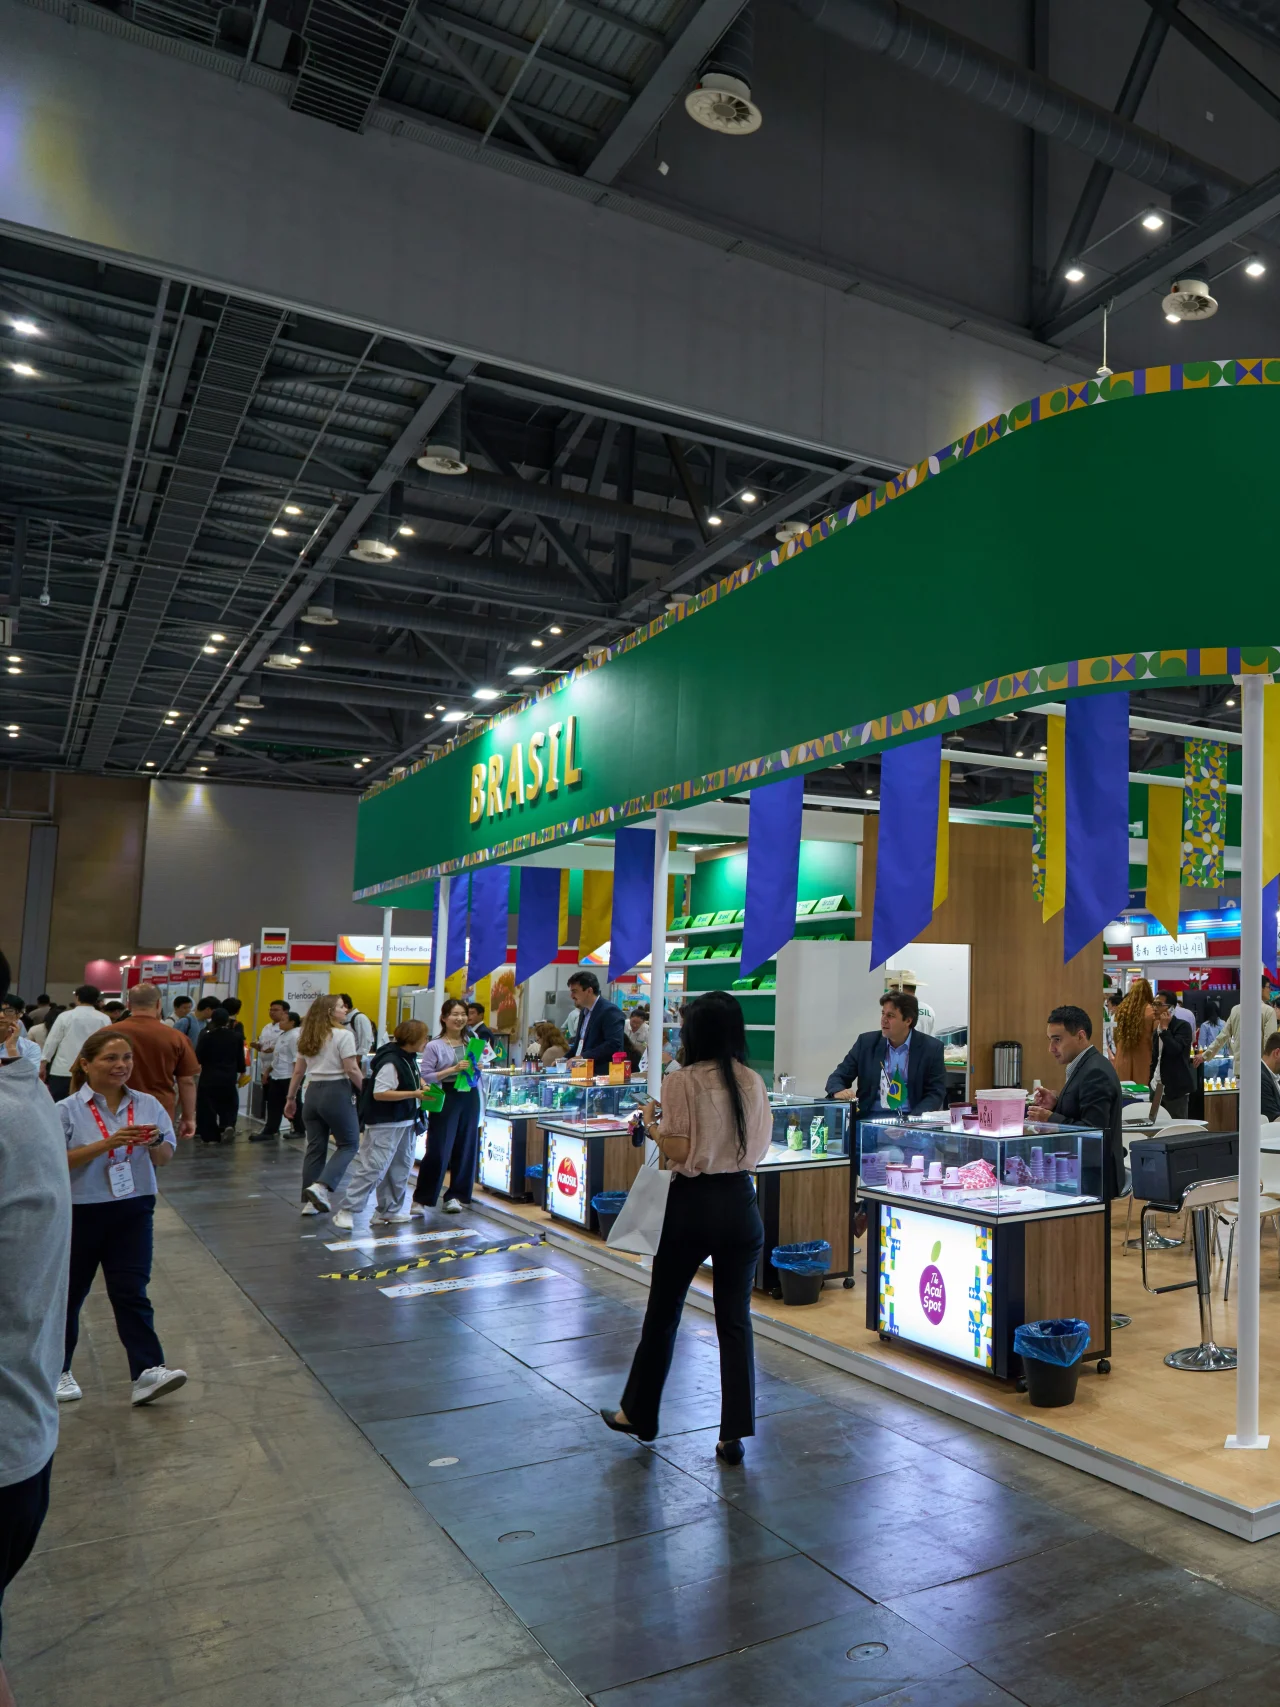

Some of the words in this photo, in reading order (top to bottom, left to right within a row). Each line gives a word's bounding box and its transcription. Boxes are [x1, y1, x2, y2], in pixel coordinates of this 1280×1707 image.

[469, 715, 582, 824] BRASIL
[1155, 945, 1168, 955] 대만
[1170, 944, 1189, 955] 타이난
[1191, 942, 1204, 953] 시티
[919, 1008, 931, 1017] SIL
[558, 1173, 577, 1188] AGROSUL
[924, 1282, 943, 1299] Açaí
[923, 1295, 942, 1313] Spot
